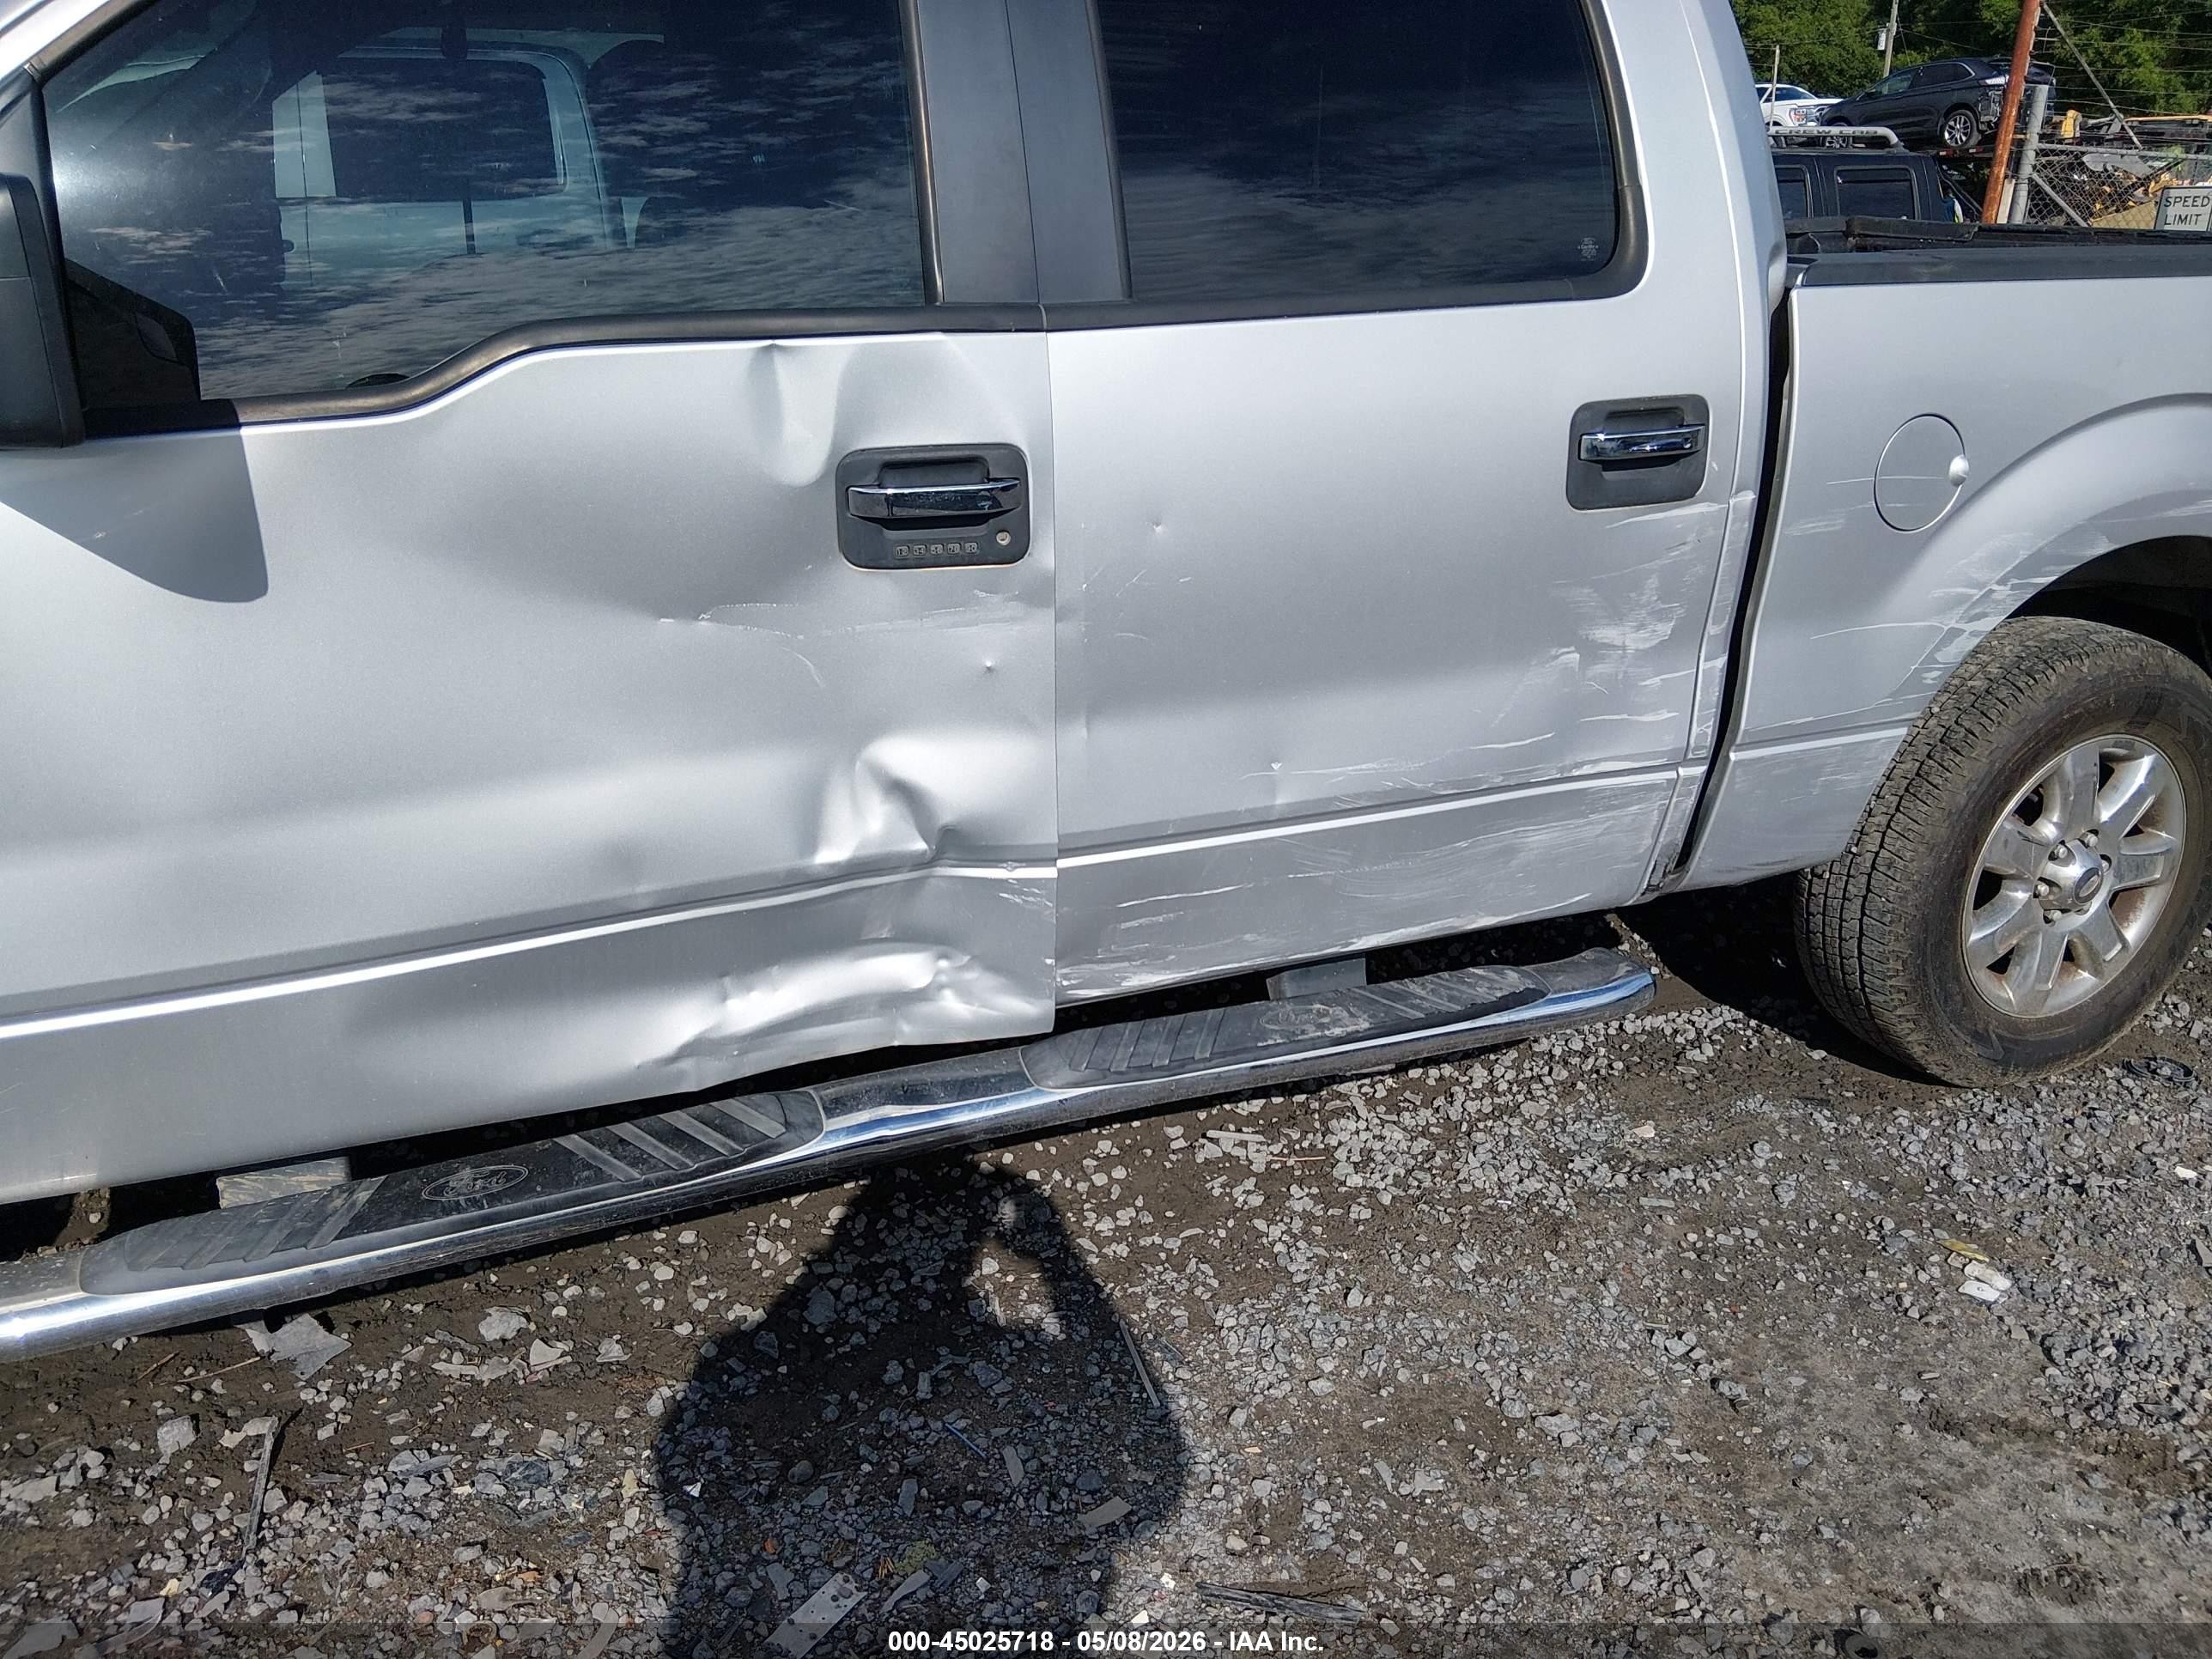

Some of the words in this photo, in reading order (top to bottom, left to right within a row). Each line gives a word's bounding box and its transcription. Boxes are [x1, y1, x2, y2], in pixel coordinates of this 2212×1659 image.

[2164, 196, 2210, 208] SPEED
[2164, 214, 2202, 226] LIMIT
[443, 1170, 508, 1197] Ford
